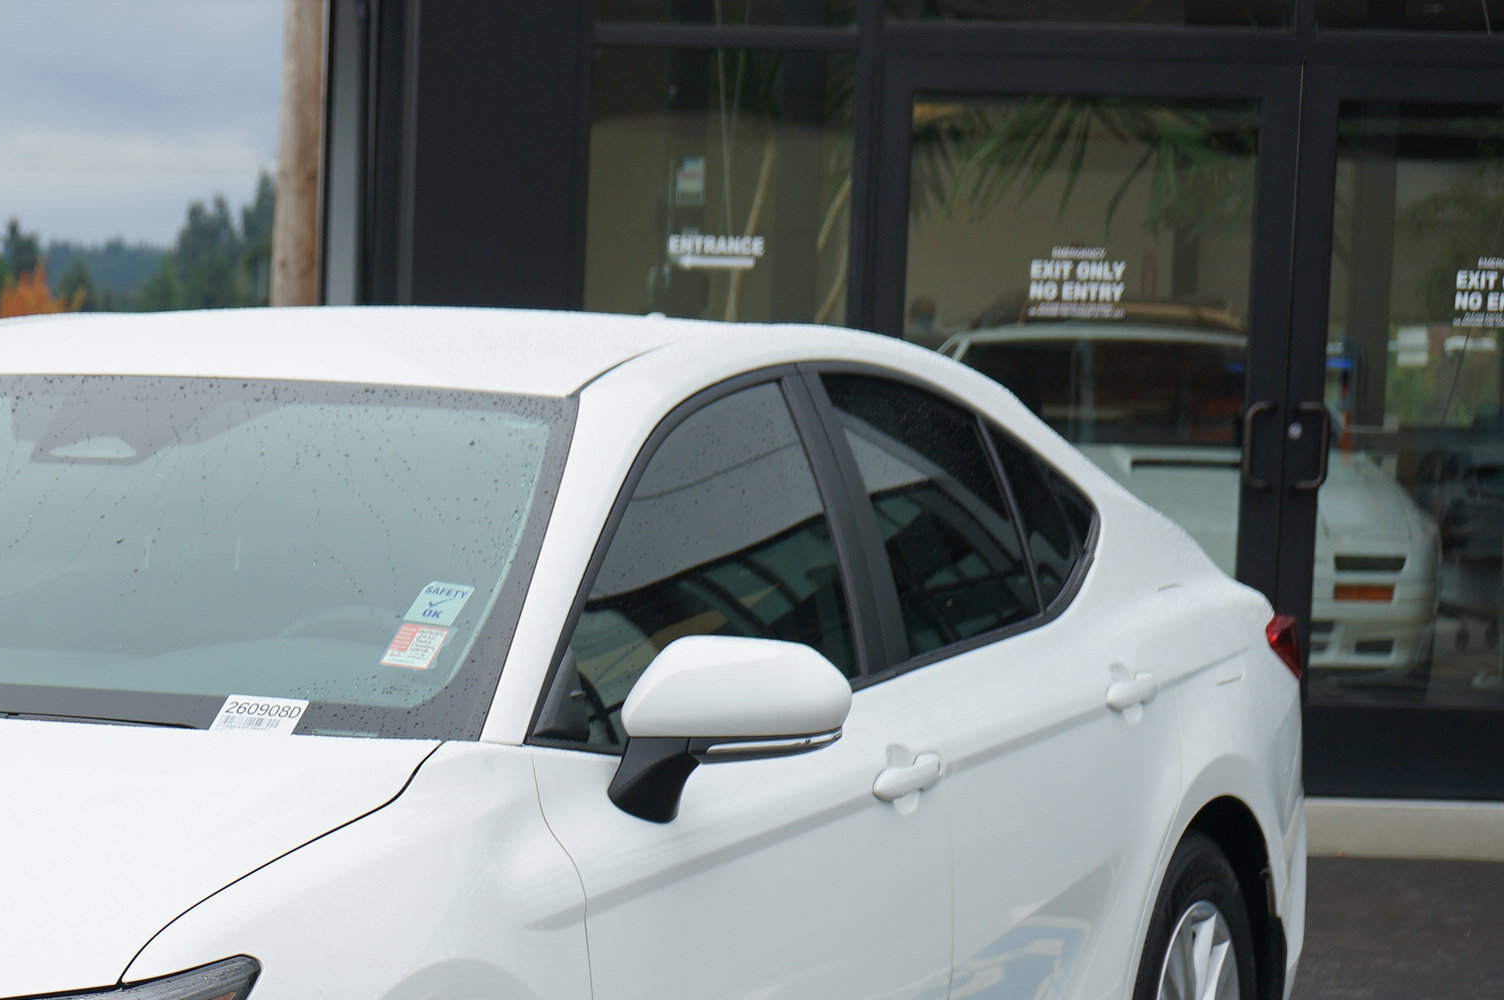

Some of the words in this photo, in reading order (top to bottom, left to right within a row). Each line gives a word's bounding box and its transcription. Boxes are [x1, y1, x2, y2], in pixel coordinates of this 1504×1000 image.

[669, 234, 765, 256] ENTRANCE
[1031, 260, 1074, 280] EXIT
[1077, 260, 1126, 281] ONLY
[1456, 270, 1499, 290] EXIT
[1030, 281, 1058, 301] NO
[1062, 281, 1125, 303] ENTRY
[1455, 290, 1483, 311] NO
[425, 586, 468, 598] SAFETY
[422, 608, 442, 618] OK
[224, 701, 302, 718] 260908D
